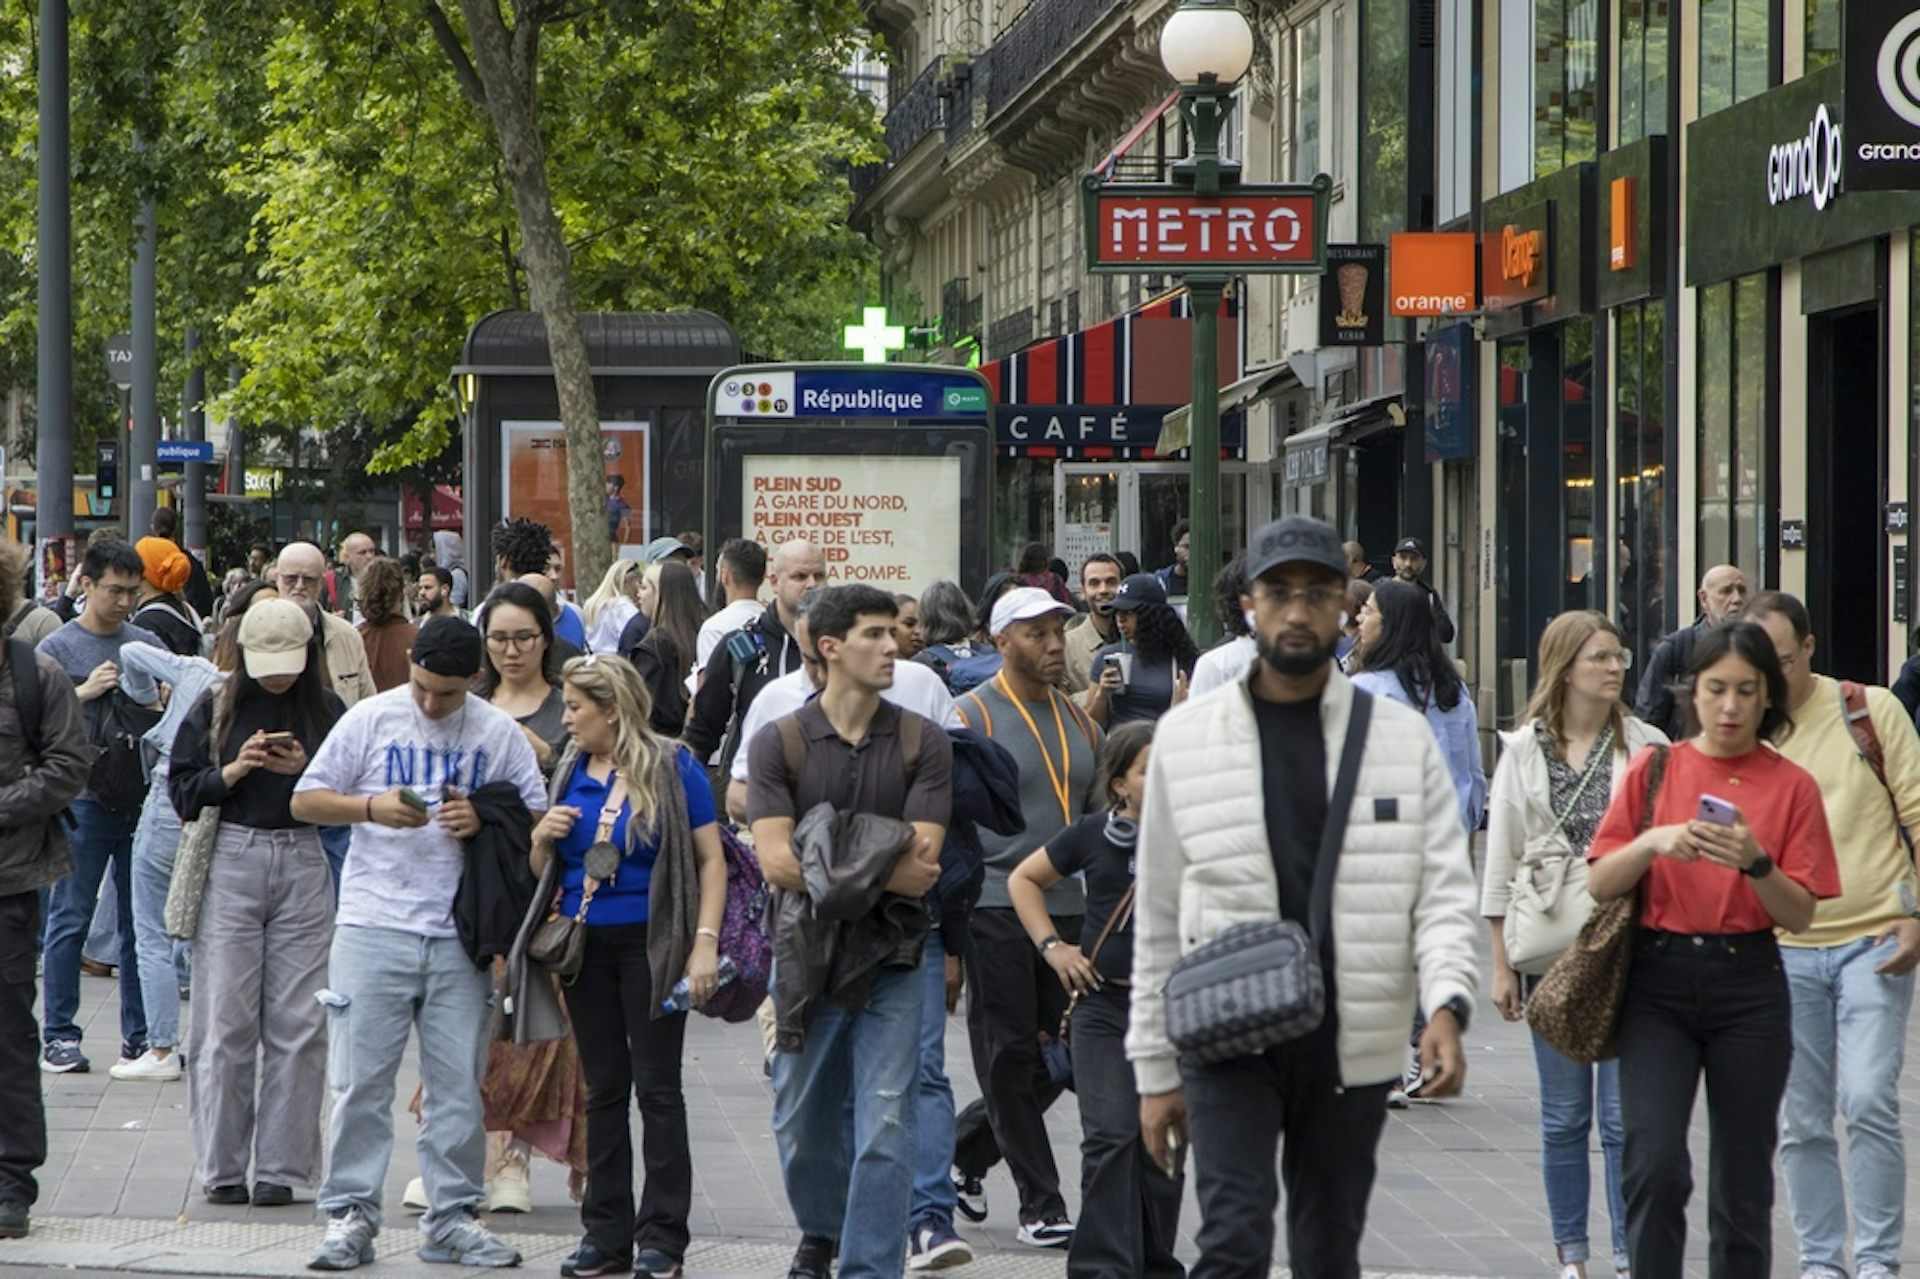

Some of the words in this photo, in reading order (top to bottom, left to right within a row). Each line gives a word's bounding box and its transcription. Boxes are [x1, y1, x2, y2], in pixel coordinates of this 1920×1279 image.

[1113, 207, 1301, 252] METRO
[1395, 295, 1467, 314] orange
[803, 388, 923, 413] République
[1009, 412, 1128, 440] CAFÉ
[754, 477, 802, 492] PLEIN
[806, 477, 842, 492] SUD
[754, 490, 767, 510] À
[771, 495, 819, 510] GARE
[824, 495, 848, 510] DU
[853, 495, 908, 514] NORD,
[754, 512, 802, 527] PLEIN
[805, 512, 864, 528] OUEST
[771, 530, 818, 545] GARE
[824, 530, 846, 545] DE
[844, 566, 911, 581] POMPE.
[384, 738, 490, 791] NIKE
